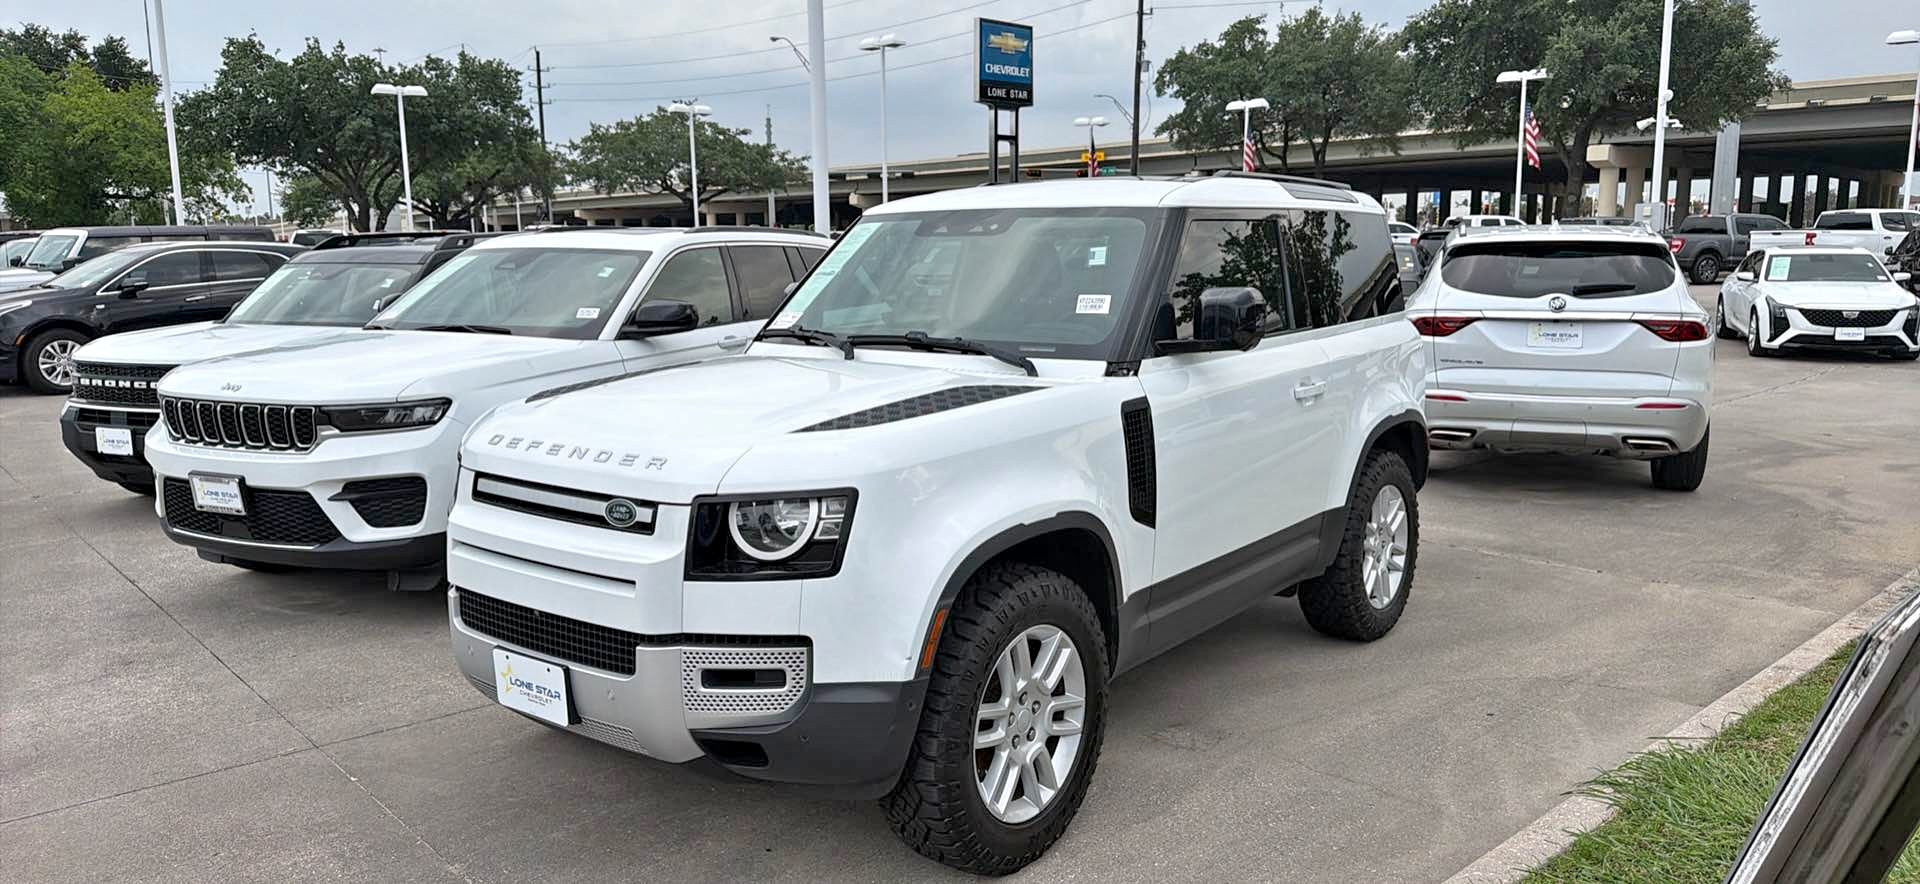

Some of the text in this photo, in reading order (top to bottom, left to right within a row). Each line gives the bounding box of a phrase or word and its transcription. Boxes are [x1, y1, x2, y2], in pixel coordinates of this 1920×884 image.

[985, 63, 1030, 77] CHEVROLET
[988, 87, 1028, 99] LONE STAR
[80, 378, 159, 389] BRONCO
[488, 433, 668, 471] DEFENDER
[509, 676, 561, 700] LONE STAR
